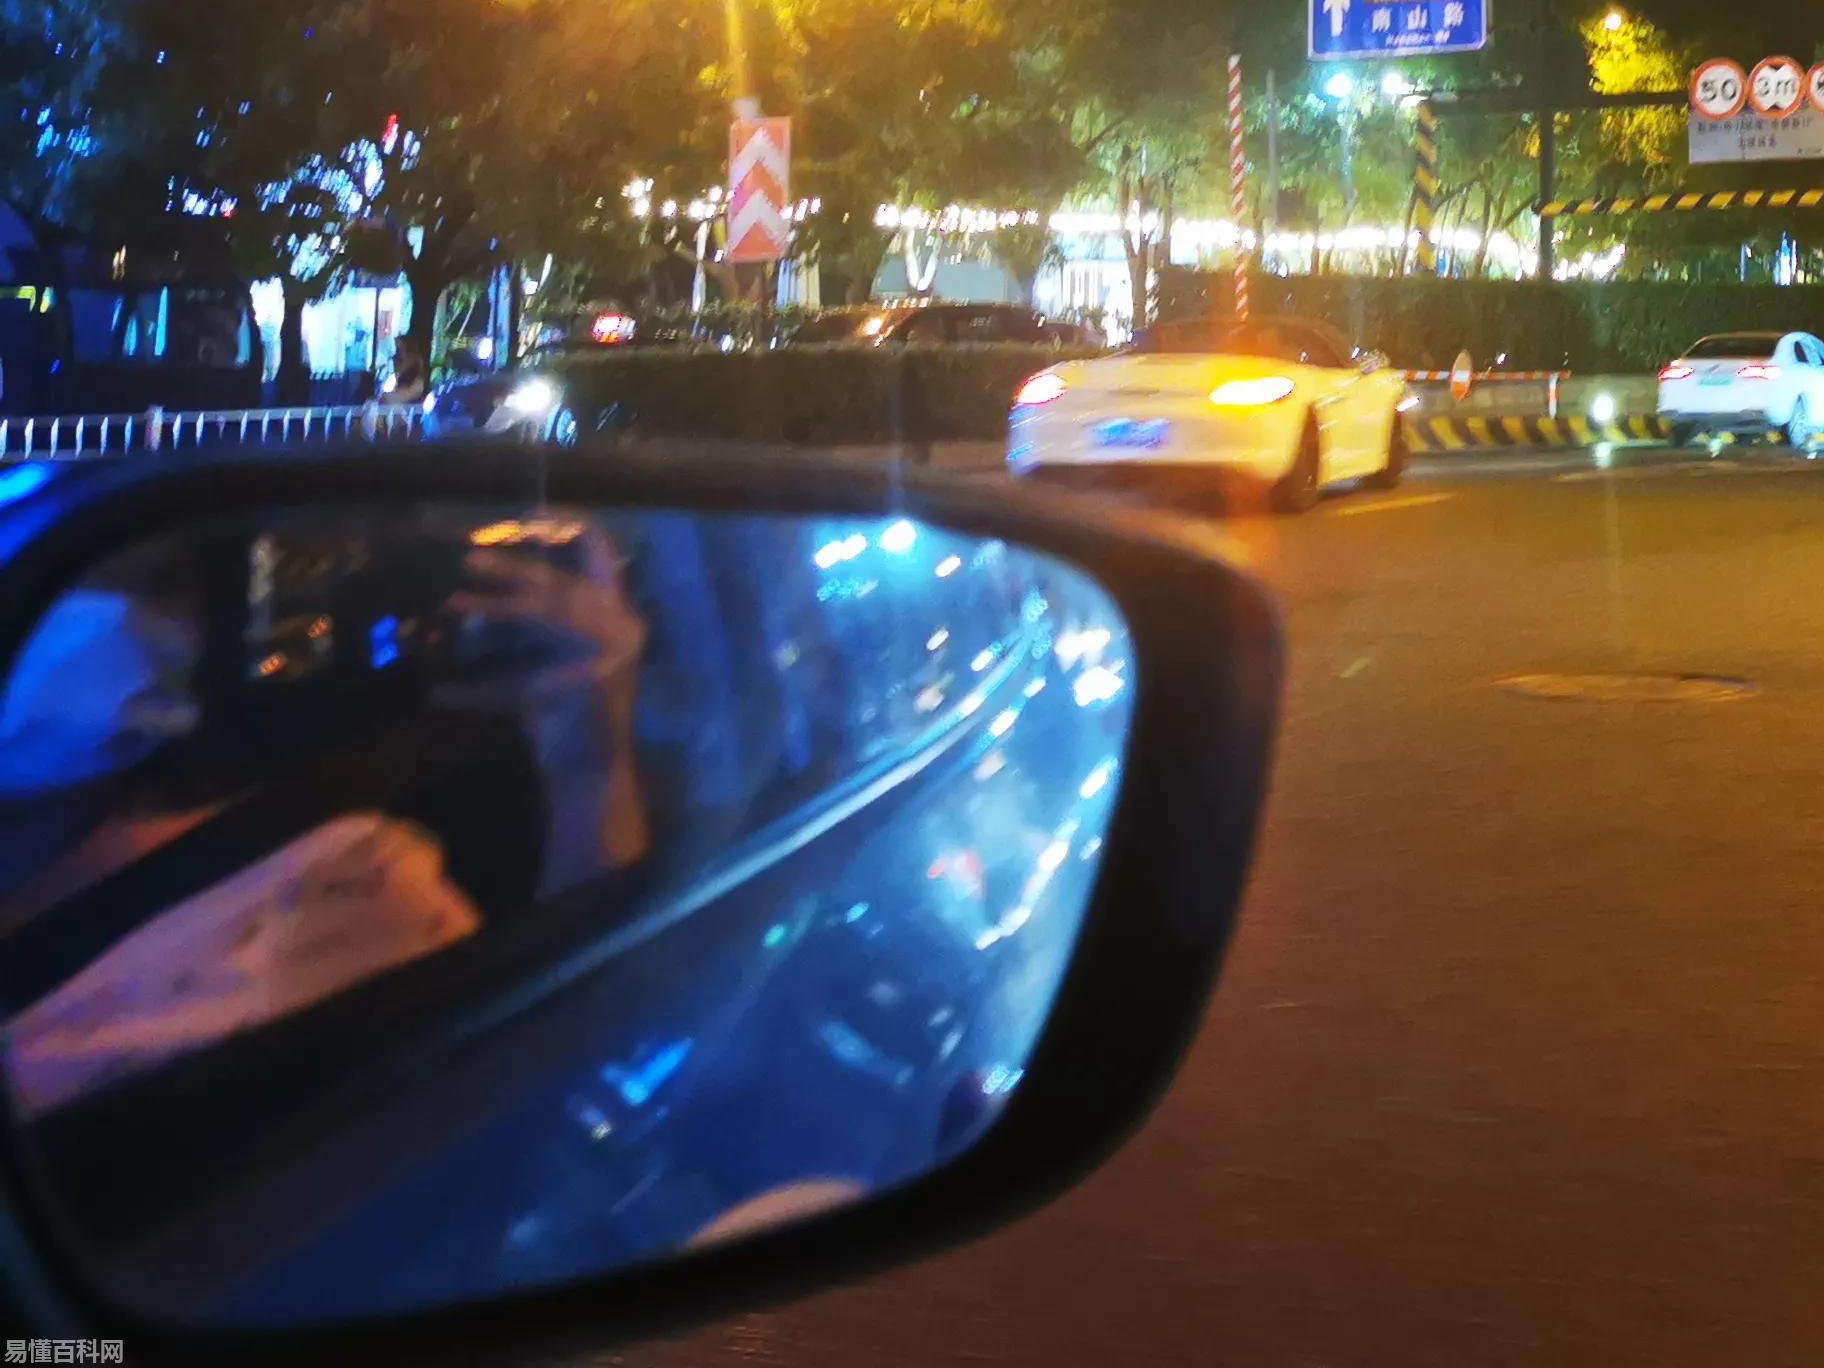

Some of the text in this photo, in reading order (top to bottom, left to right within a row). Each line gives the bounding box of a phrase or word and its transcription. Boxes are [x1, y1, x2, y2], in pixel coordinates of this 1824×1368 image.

[1371, 0, 1465, 33] 南山路
[1700, 77, 1738, 103] 50
[1756, 76, 1797, 99] 3m
